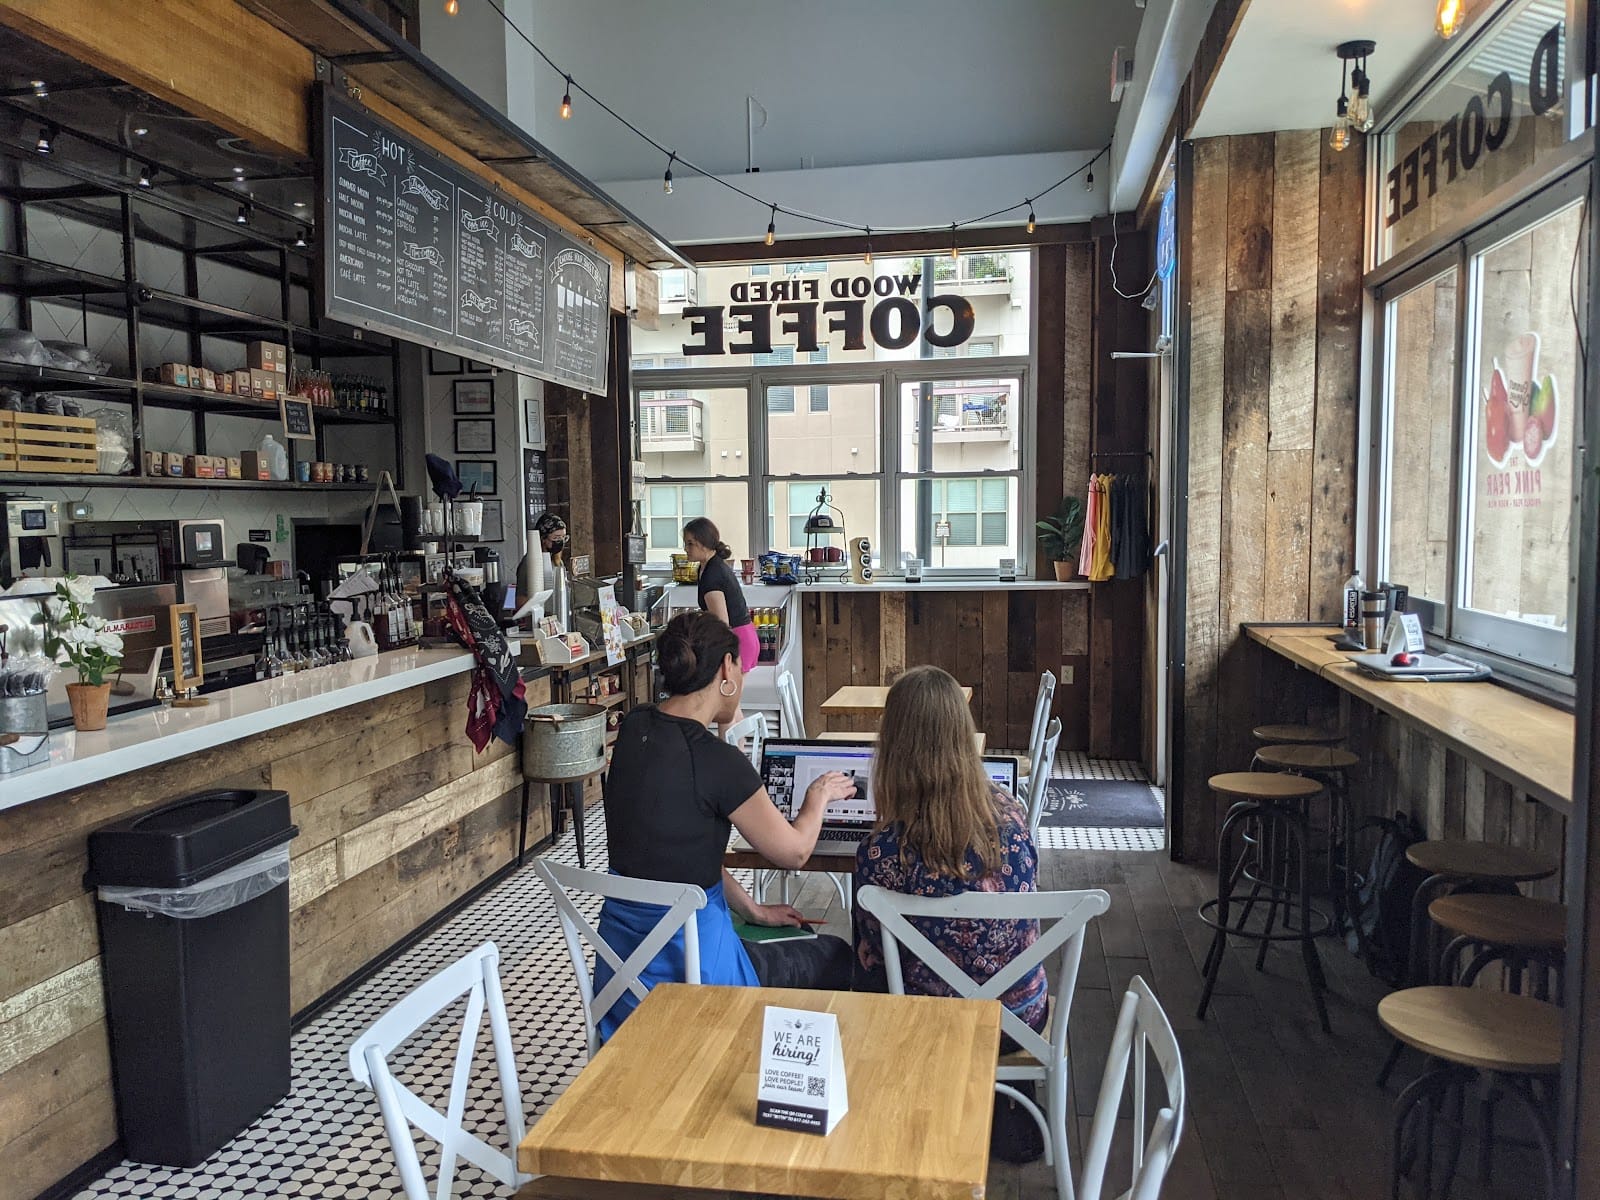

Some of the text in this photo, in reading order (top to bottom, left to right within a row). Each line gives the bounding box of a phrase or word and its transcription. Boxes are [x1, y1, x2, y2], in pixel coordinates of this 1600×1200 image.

[382, 137, 406, 165] HOT
[352, 156, 372, 170] Coffee
[338, 176, 370, 200] SUMMER MOON
[338, 192, 364, 210] HALF MOON
[338, 208, 366, 226] MOCHA MOON
[396, 208, 414, 224] CORTADO
[493, 202, 516, 226] COLD
[338, 224, 368, 242] MOCHA LATTE
[340, 254, 363, 269] AMERICANO
[560, 251, 574, 264] CHOOSE
[408, 280, 420, 291] LATTE
[774, 1031, 821, 1048] WE ARE
[772, 1042, 820, 1066] hiring!
[780, 1071, 804, 1079] COFFEE?
[780, 1078, 804, 1086] PEOPLE?
